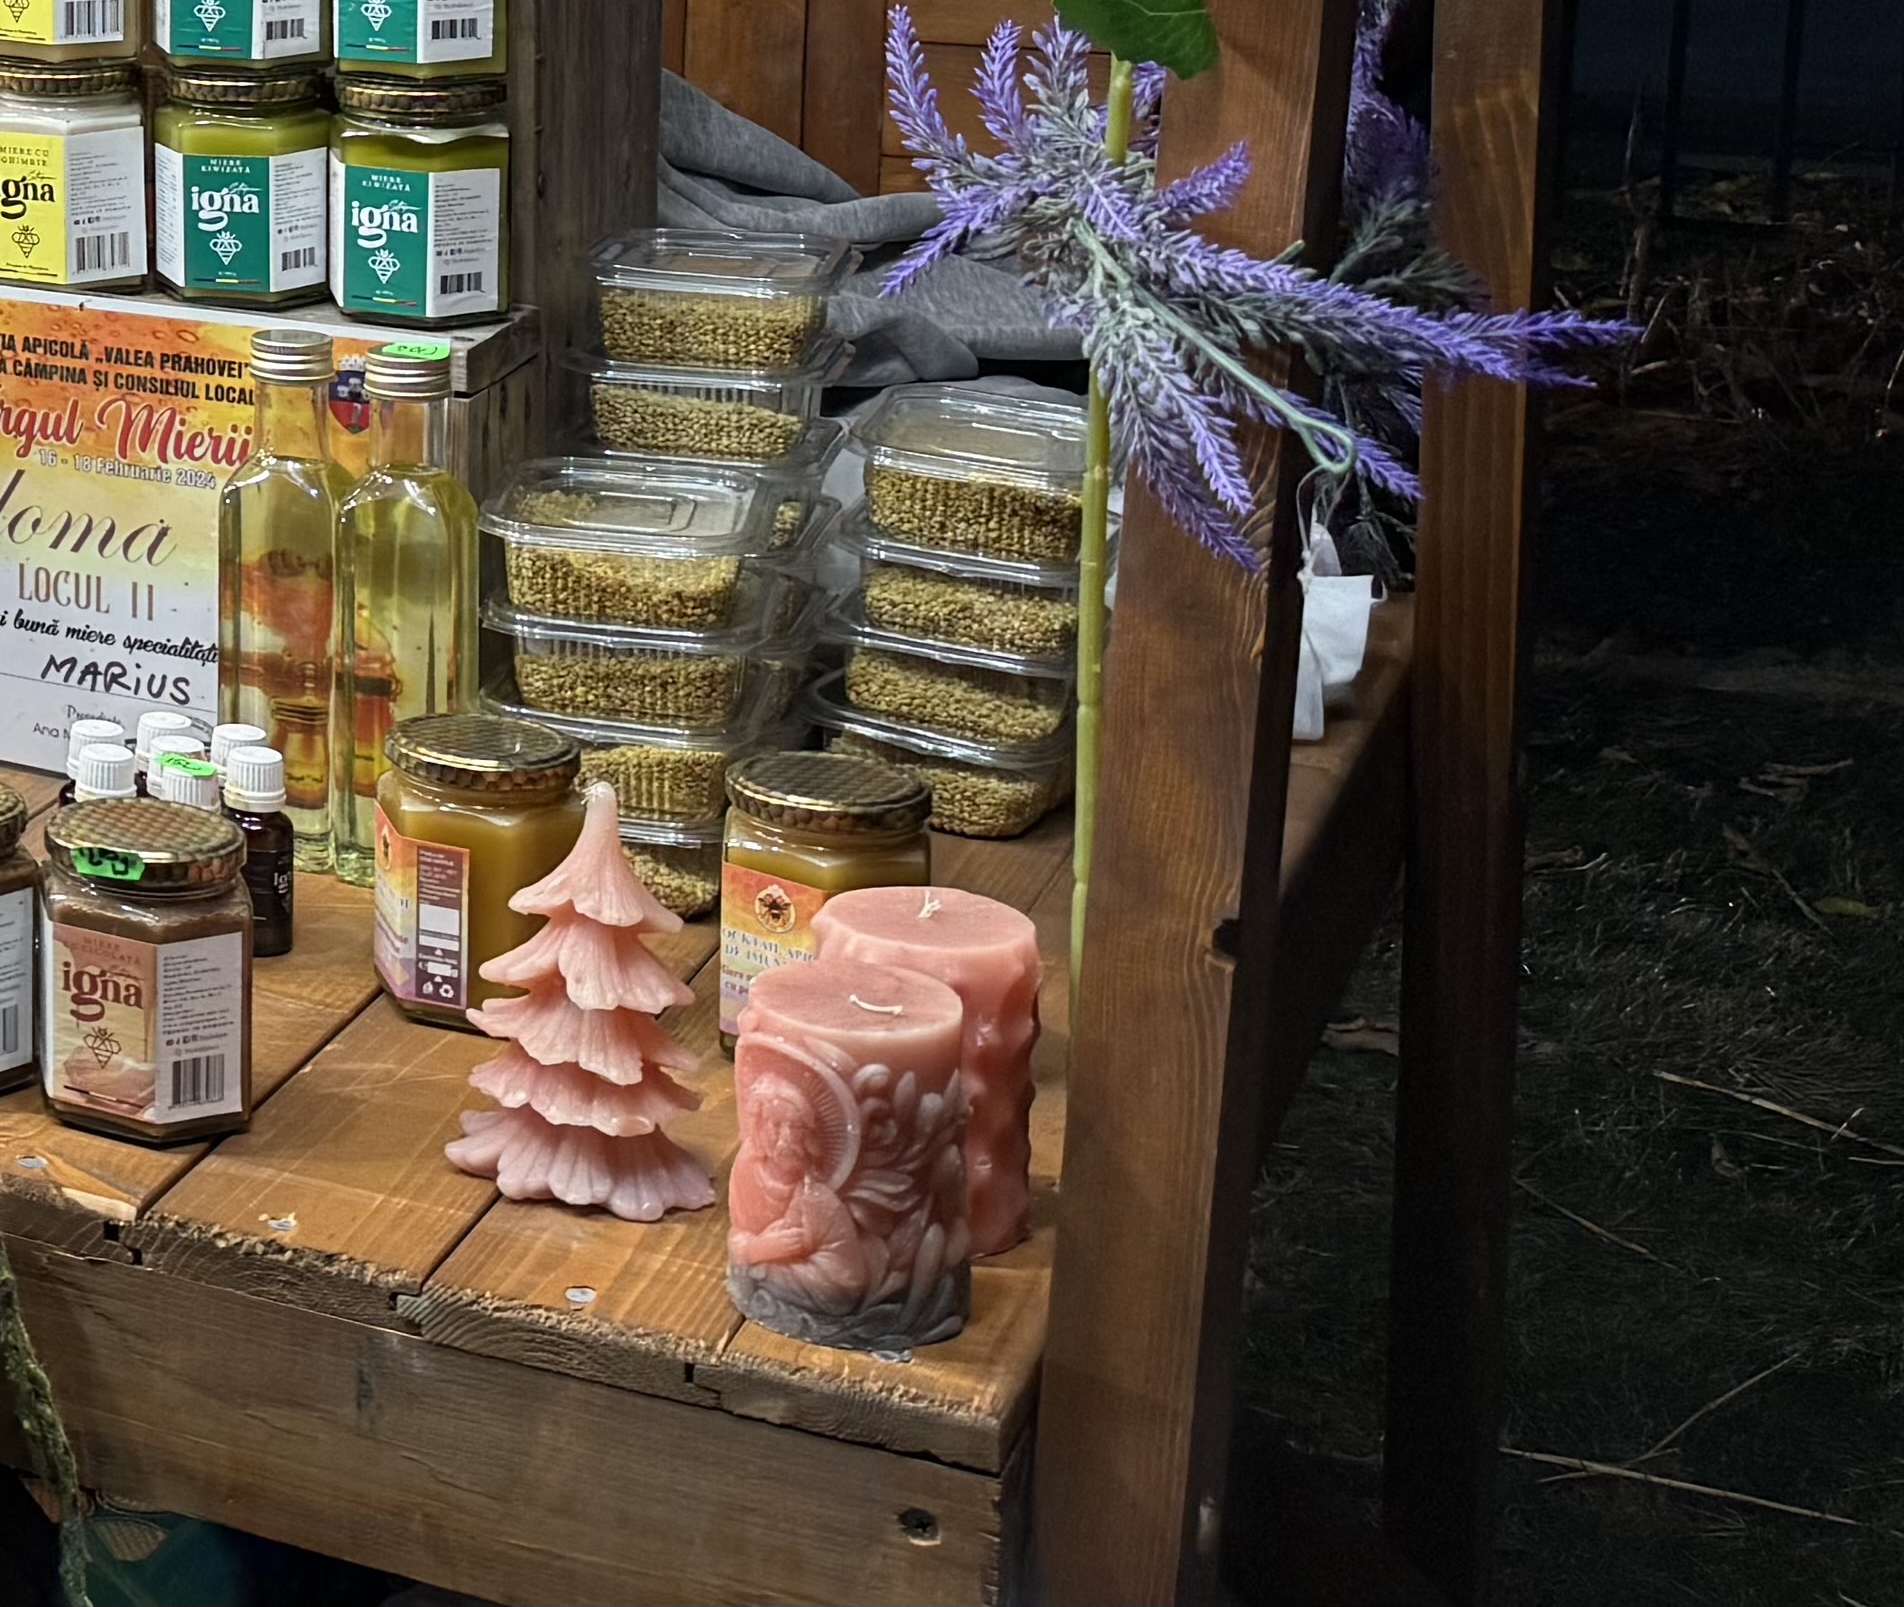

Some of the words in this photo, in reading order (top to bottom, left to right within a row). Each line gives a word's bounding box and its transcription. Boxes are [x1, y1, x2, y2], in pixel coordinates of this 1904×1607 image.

[0, 146, 29, 156] MIERE
[192, 186, 260, 231] igna
[352, 201, 418, 248] igna
[22, 337, 90, 360] APICOLĂ
[14, 360, 87, 385] CÂMPINA
[113, 373, 200, 400] CONSILIUL
[96, 398, 253, 467] Mierii
[38, 449, 57, 467] 16
[74, 454, 92, 473] 18
[176, 470, 216, 490] 2024
[19, 562, 110, 613] LOCUL
[13, 609, 60, 636] bună
[65, 625, 115, 645] miere
[61, 961, 144, 1022] igna
